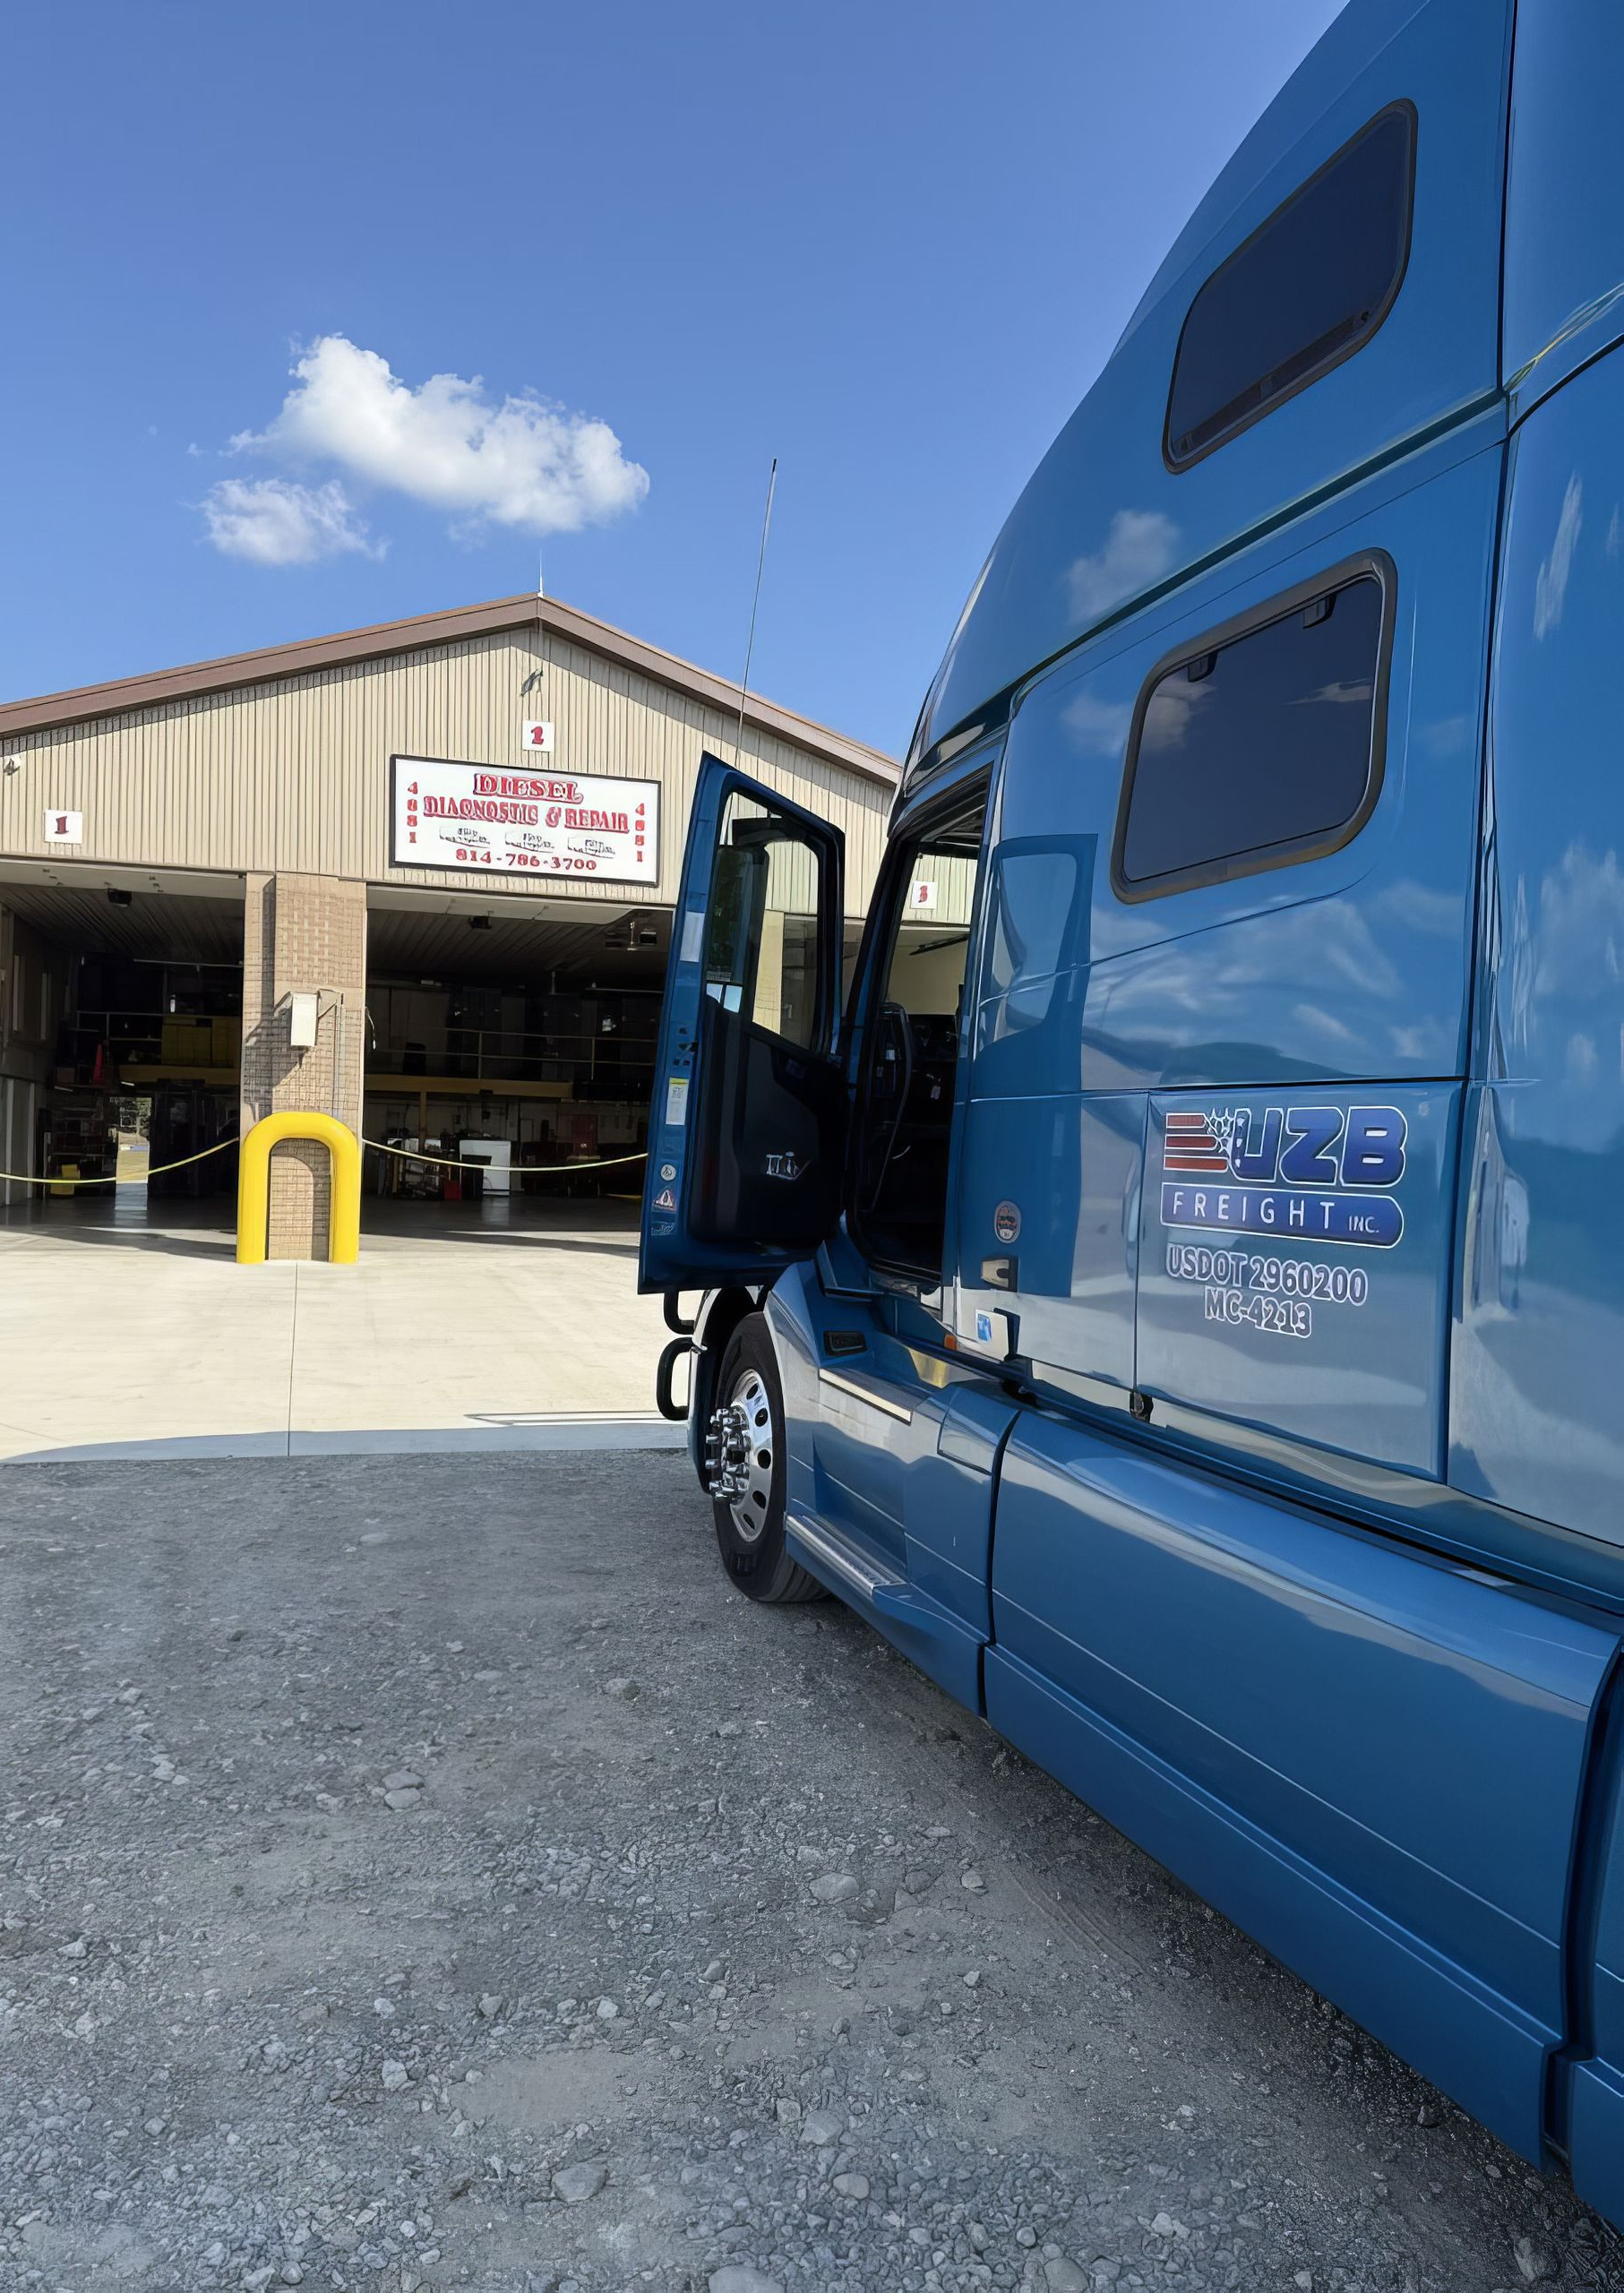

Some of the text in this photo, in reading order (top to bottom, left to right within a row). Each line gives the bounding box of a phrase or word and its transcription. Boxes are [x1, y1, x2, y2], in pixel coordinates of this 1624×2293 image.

[474, 773, 584, 804] DIESEL
[55, 815, 69, 835] 1
[423, 795, 630, 834] DIAGNOSTIC & REPAIR
[455, 847, 597, 871] 814-786-3700
[1228, 1105, 1409, 1189] UZB
[1173, 1190, 1336, 1230] FREIGHT
[1166, 1242, 1369, 1307] USDOT 2960200
[1204, 1284, 1312, 1339] MC-4213
